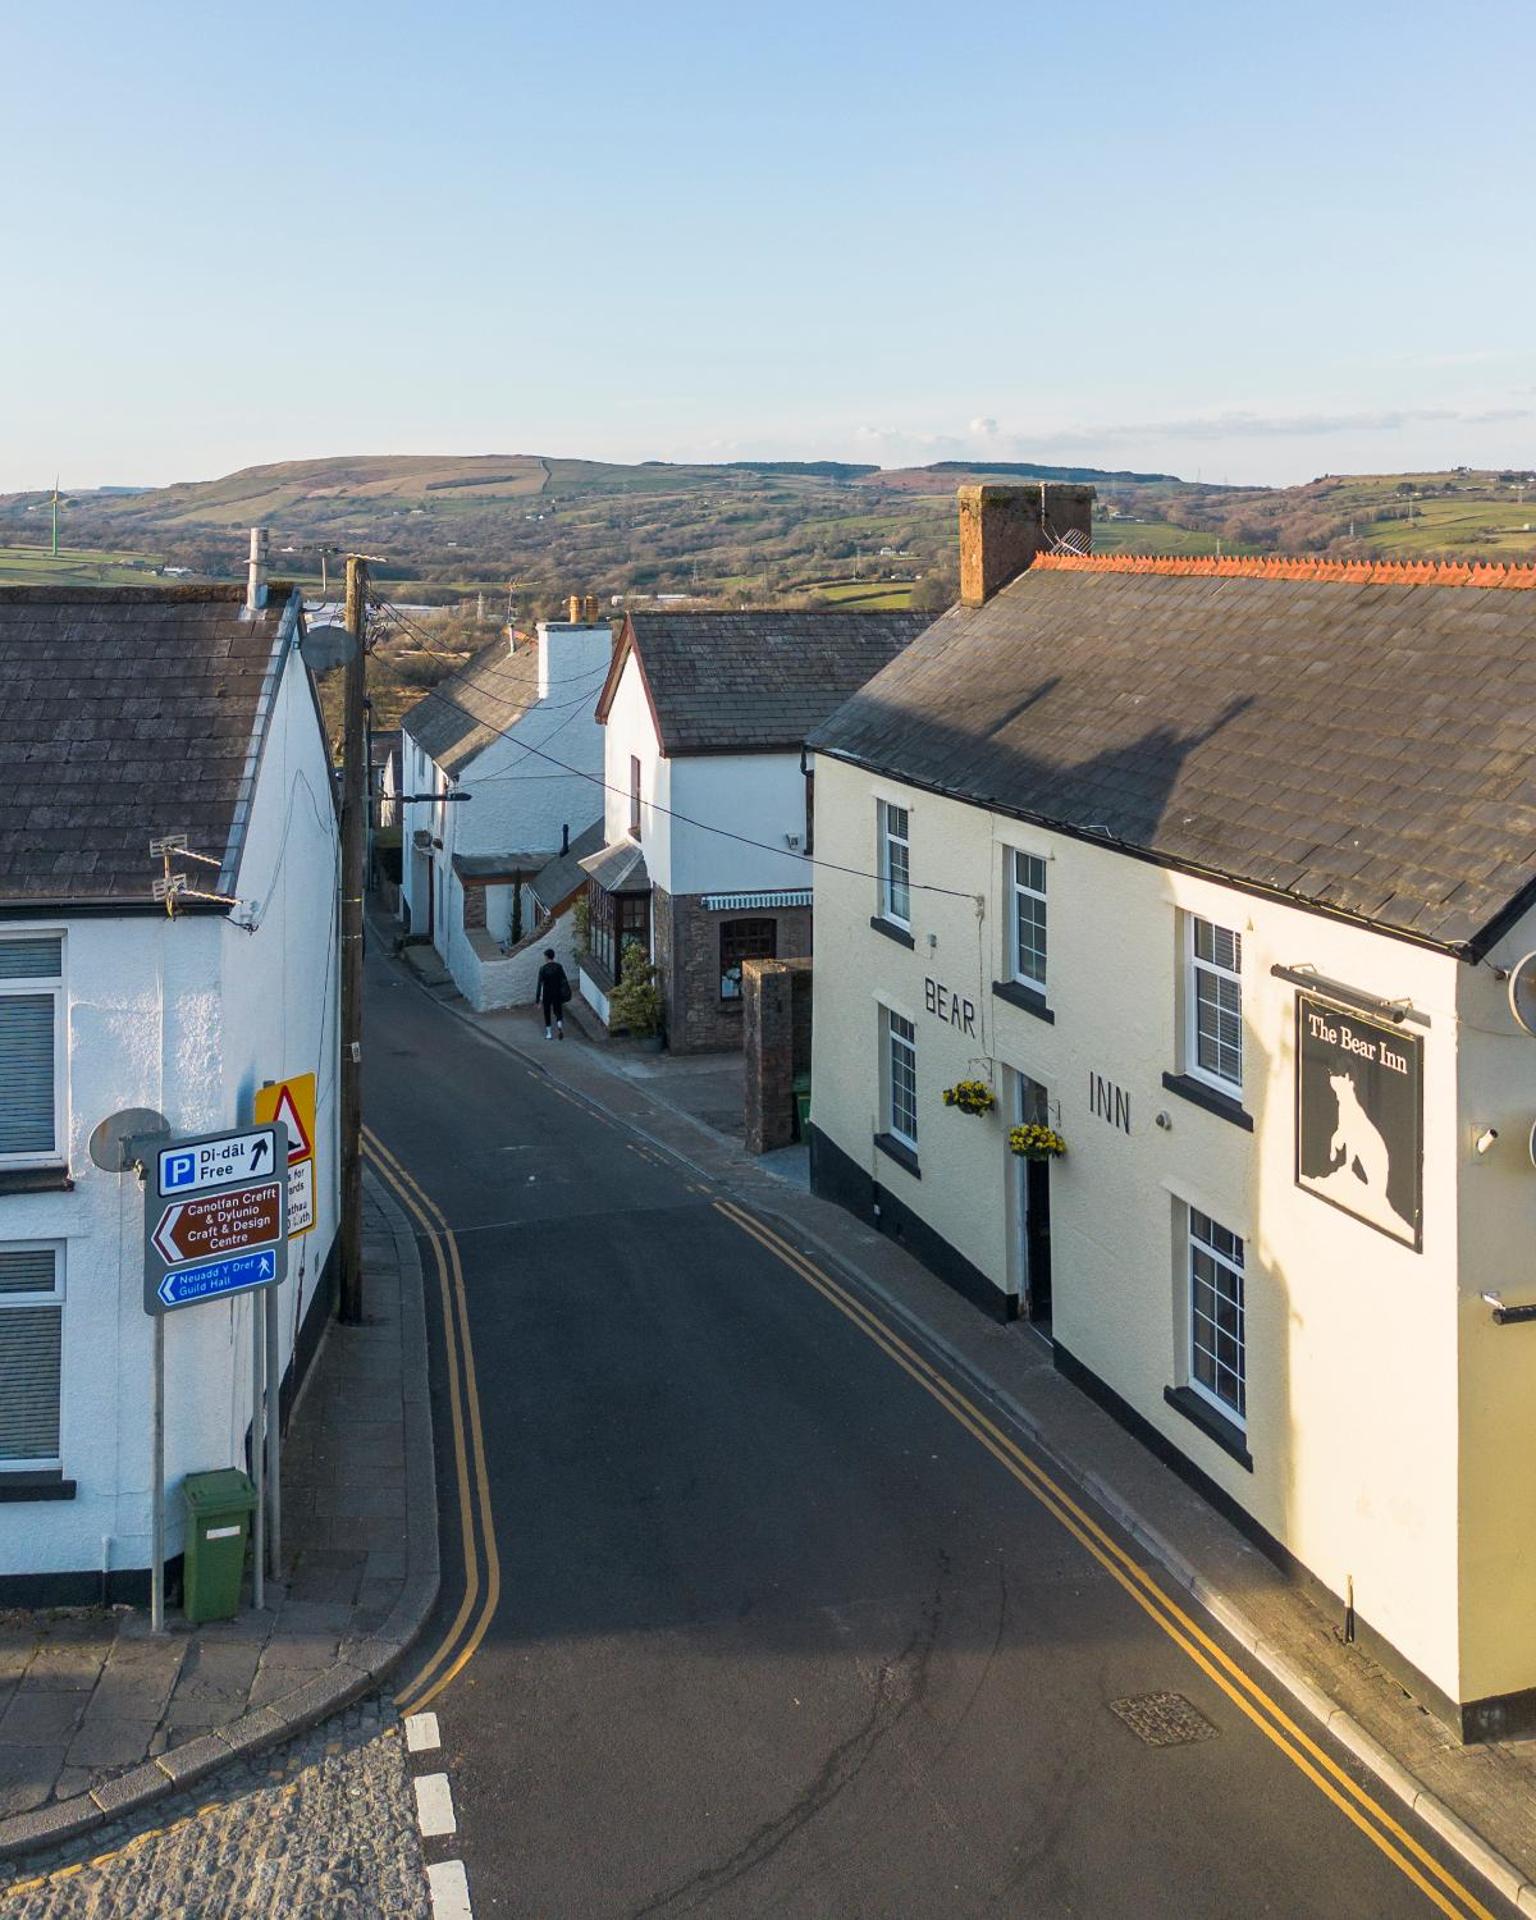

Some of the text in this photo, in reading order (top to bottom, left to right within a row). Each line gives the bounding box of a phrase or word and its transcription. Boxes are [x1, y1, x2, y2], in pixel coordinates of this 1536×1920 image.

[925, 977, 975, 1038] BEAR
[1309, 1014, 1408, 1074] The Bear Inn
[1090, 1072, 1130, 1134] INN
[200, 1143, 245, 1163] Di-dâl
[172, 1158, 191, 1184] P
[200, 1165, 233, 1180] Free
[187, 1189, 277, 1216] Canolfan Crefft
[206, 1206, 259, 1225] & Dylunio
[187, 1225, 218, 1241] Craft
[222, 1224, 230, 1234] &
[233, 1216, 270, 1232] Design
[210, 1234, 248, 1249] Centre
[180, 1268, 219, 1285] Neuadd
[222, 1265, 229, 1274] Y
[179, 1277, 231, 1296] Guild Hall
